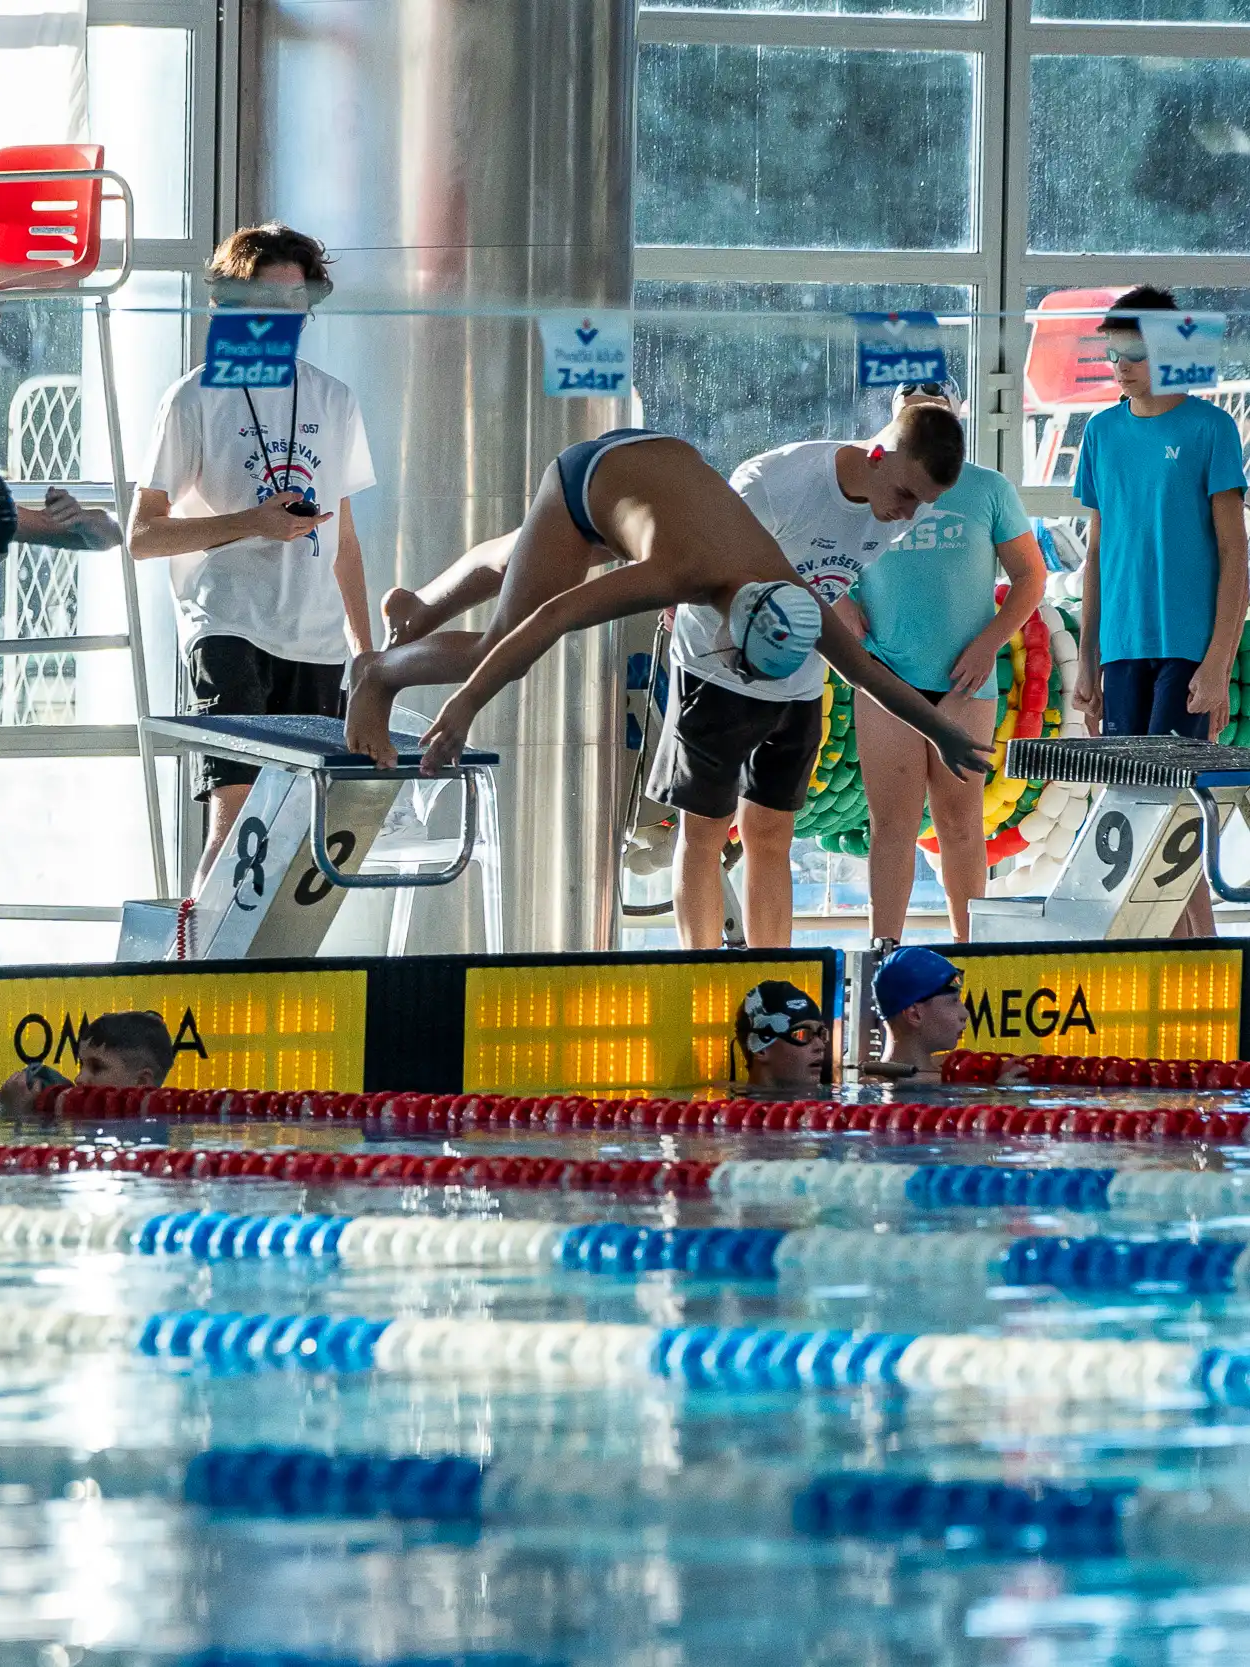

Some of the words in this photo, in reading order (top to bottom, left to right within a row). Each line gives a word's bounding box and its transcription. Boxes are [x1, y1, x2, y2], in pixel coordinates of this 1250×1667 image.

[212, 360, 290, 384] Zadar
[558, 368, 625, 390] Zadar
[866, 358, 938, 382] Zadar
[1159, 362, 1216, 386] Zadar
[244, 450, 263, 471] SV.
[796, 559, 818, 575] SV.
[821, 553, 864, 574] KRŠEVA
[233, 816, 269, 911] 8
[294, 830, 356, 906] 8
[1095, 810, 1133, 892] 9
[1153, 816, 1204, 888] 9
[964, 983, 1097, 1041] MEGA
[14, 1006, 209, 1065] OMA
